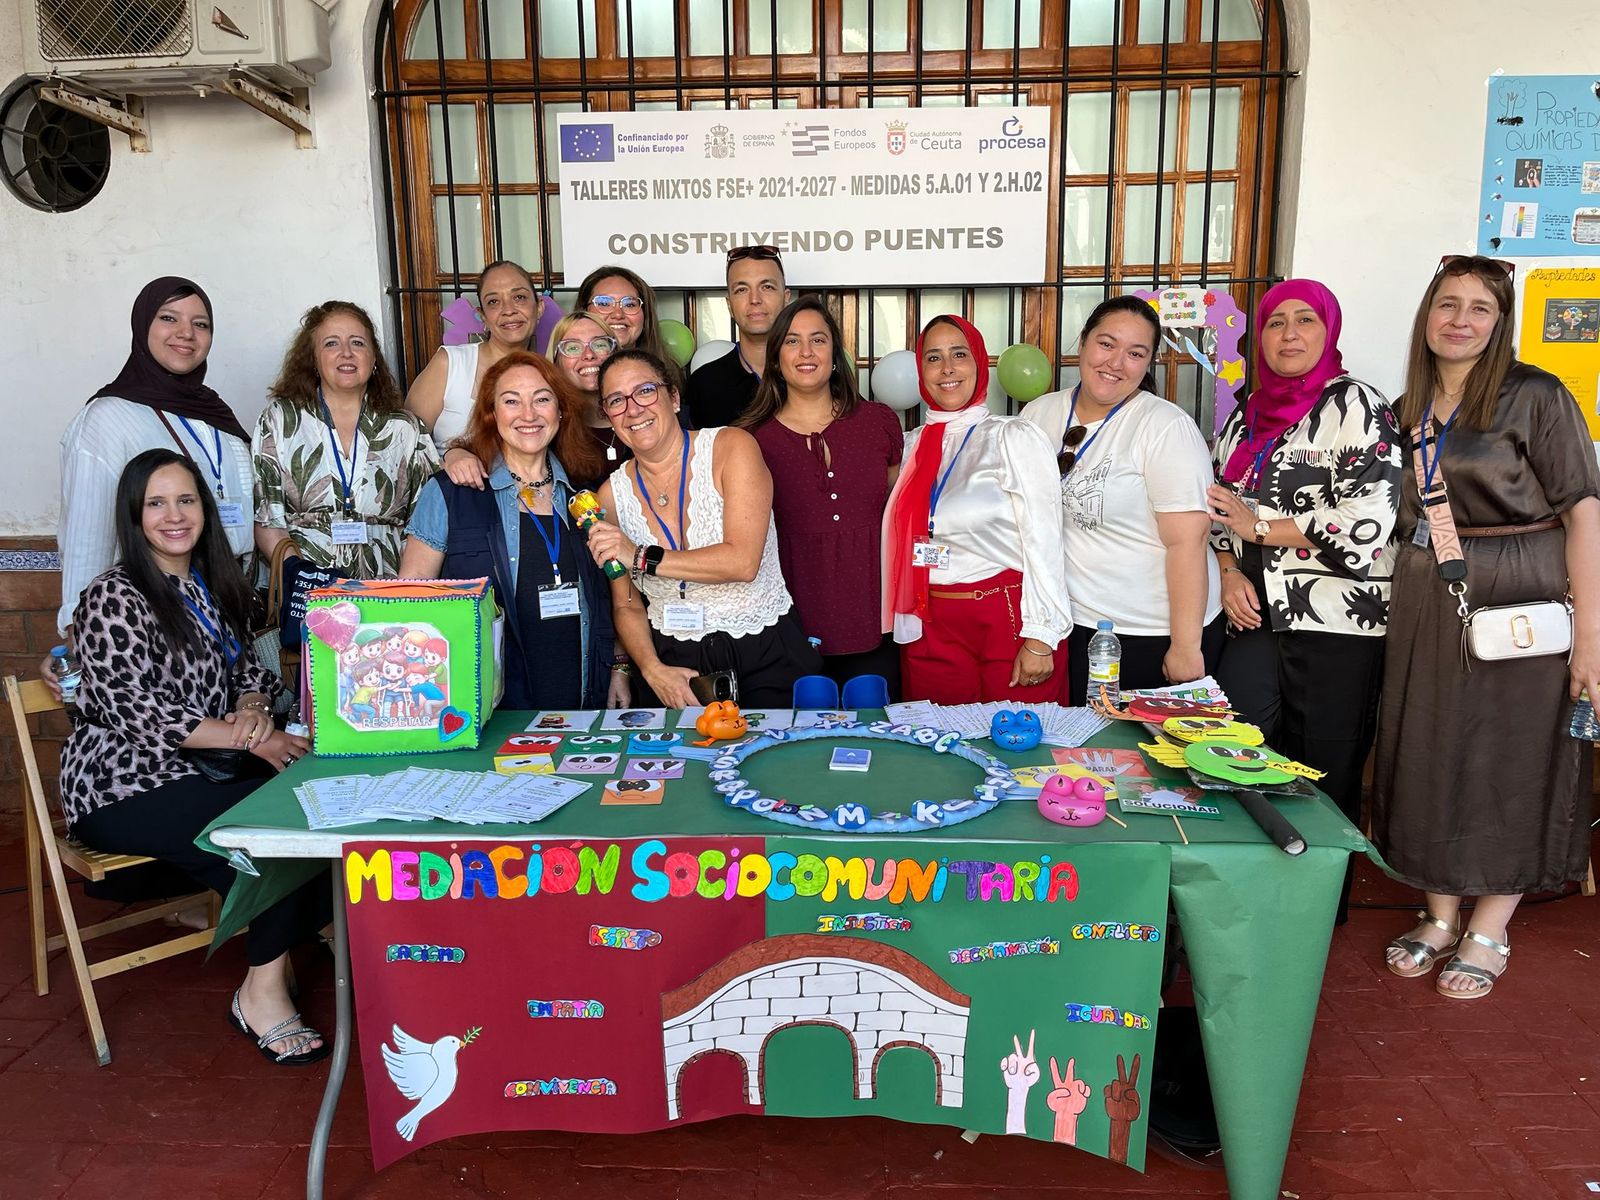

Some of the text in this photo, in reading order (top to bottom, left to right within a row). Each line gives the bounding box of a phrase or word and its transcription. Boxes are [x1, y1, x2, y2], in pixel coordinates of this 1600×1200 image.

[1535, 91, 1600, 127] PROPIED
[617, 133, 689, 143] Confinanciado por
[834, 128, 867, 137] Fondos
[932, 130, 962, 138] Autónoma
[618, 144, 685, 155] la Unión Europea
[834, 140, 876, 151] Europeos
[921, 138, 962, 150] Ceuta
[979, 137, 1046, 153] procesa
[571, 180, 648, 201] TALLERES
[653, 178, 712, 200] MIXTOS
[717, 177, 754, 198] FSE+
[759, 175, 837, 198] 2021-2027
[850, 174, 921, 196] MEDIDAS
[925, 173, 972, 194] 5.A.01
[978, 173, 989, 193] Y
[993, 171, 1042, 193] 2.H.02
[608, 227, 1004, 255] CONSTRUYENDO PUENTES
[362, 716, 432, 728] RESPETAR
[915, 728, 938, 743] B
[934, 732, 960, 753] C
[714, 756, 737, 768] S
[731, 789, 757, 804] P
[917, 801, 940, 823] K
[1124, 799, 1218, 814] SOLUCIONAR
[838, 806, 865, 825] M
[346, 840, 1079, 905] MEDIACIÓN SOCIOCOMUNITARIA
[590, 926, 662, 949] RESPETO
[1072, 924, 1160, 941] CONFLICTO
[387, 946, 464, 962] RACISMO
[949, 937, 1060, 963] DISCRIMINACIÓN
[1065, 1003, 1151, 1029] IGUALDAD
[506, 1079, 616, 1096] CONVIVENCIA
